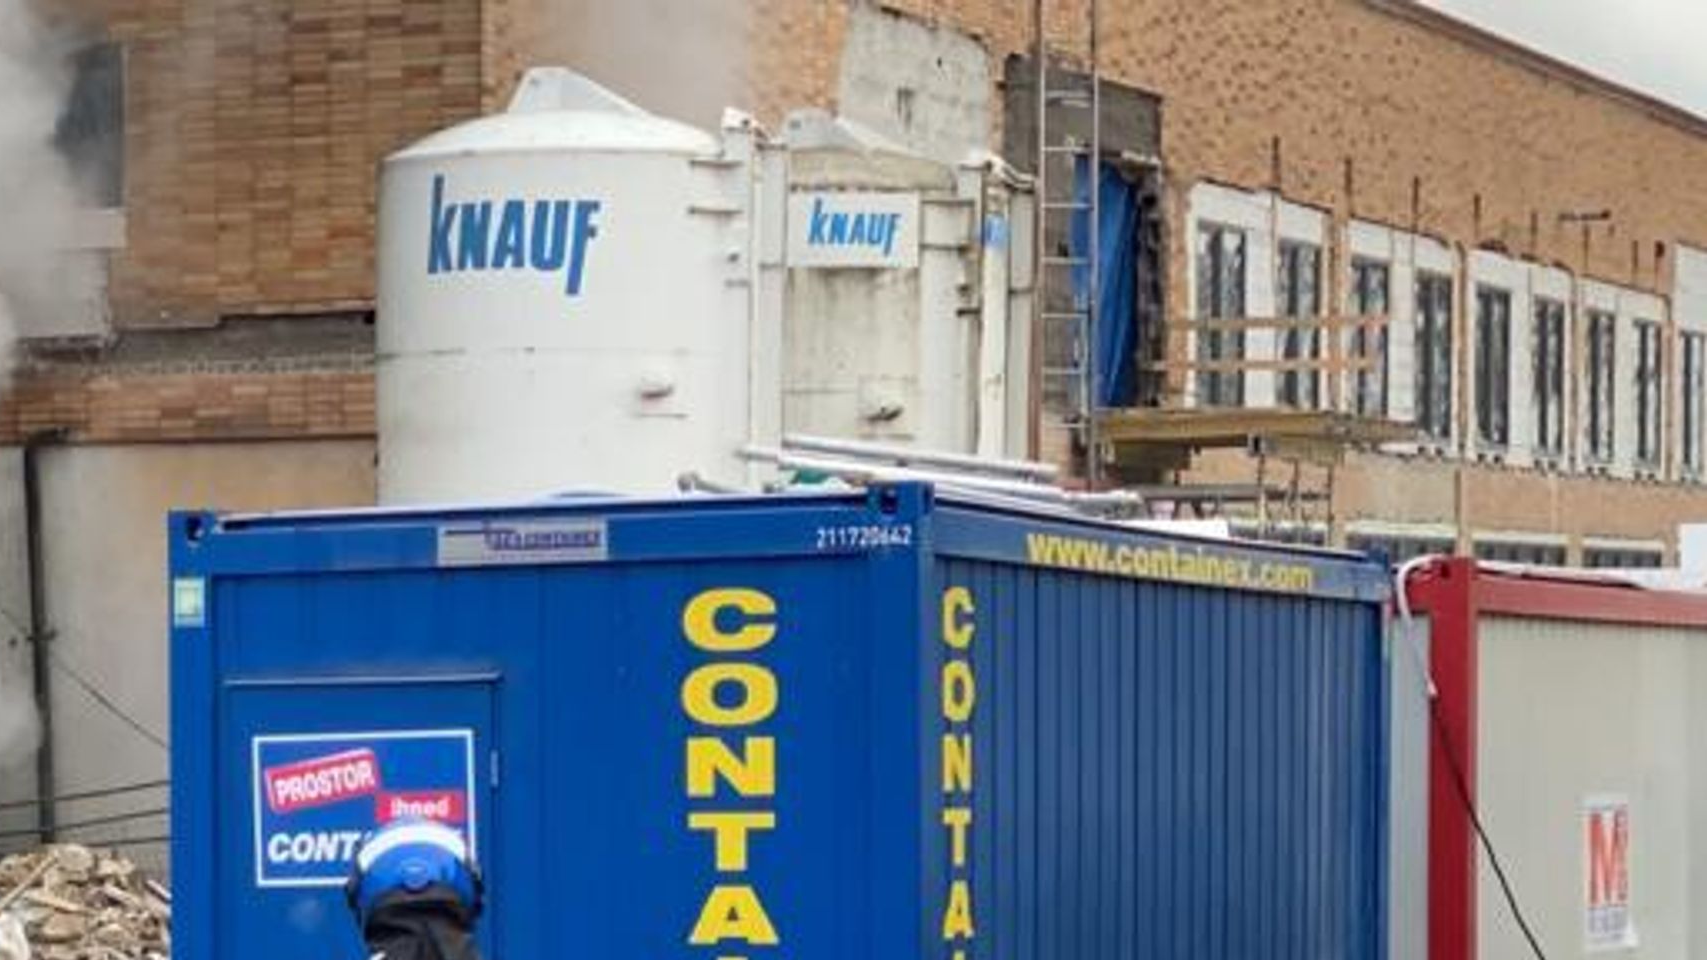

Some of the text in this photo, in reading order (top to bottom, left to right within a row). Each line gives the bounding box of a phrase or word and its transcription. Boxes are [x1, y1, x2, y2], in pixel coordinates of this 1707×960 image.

[427, 173, 600, 295] KNAUF
[808, 197, 902, 257] KNAUF
[1026, 532, 1312, 588] www.containex.com
[274, 759, 375, 805] PROSTOR
[268, 830, 373, 863] CONT
